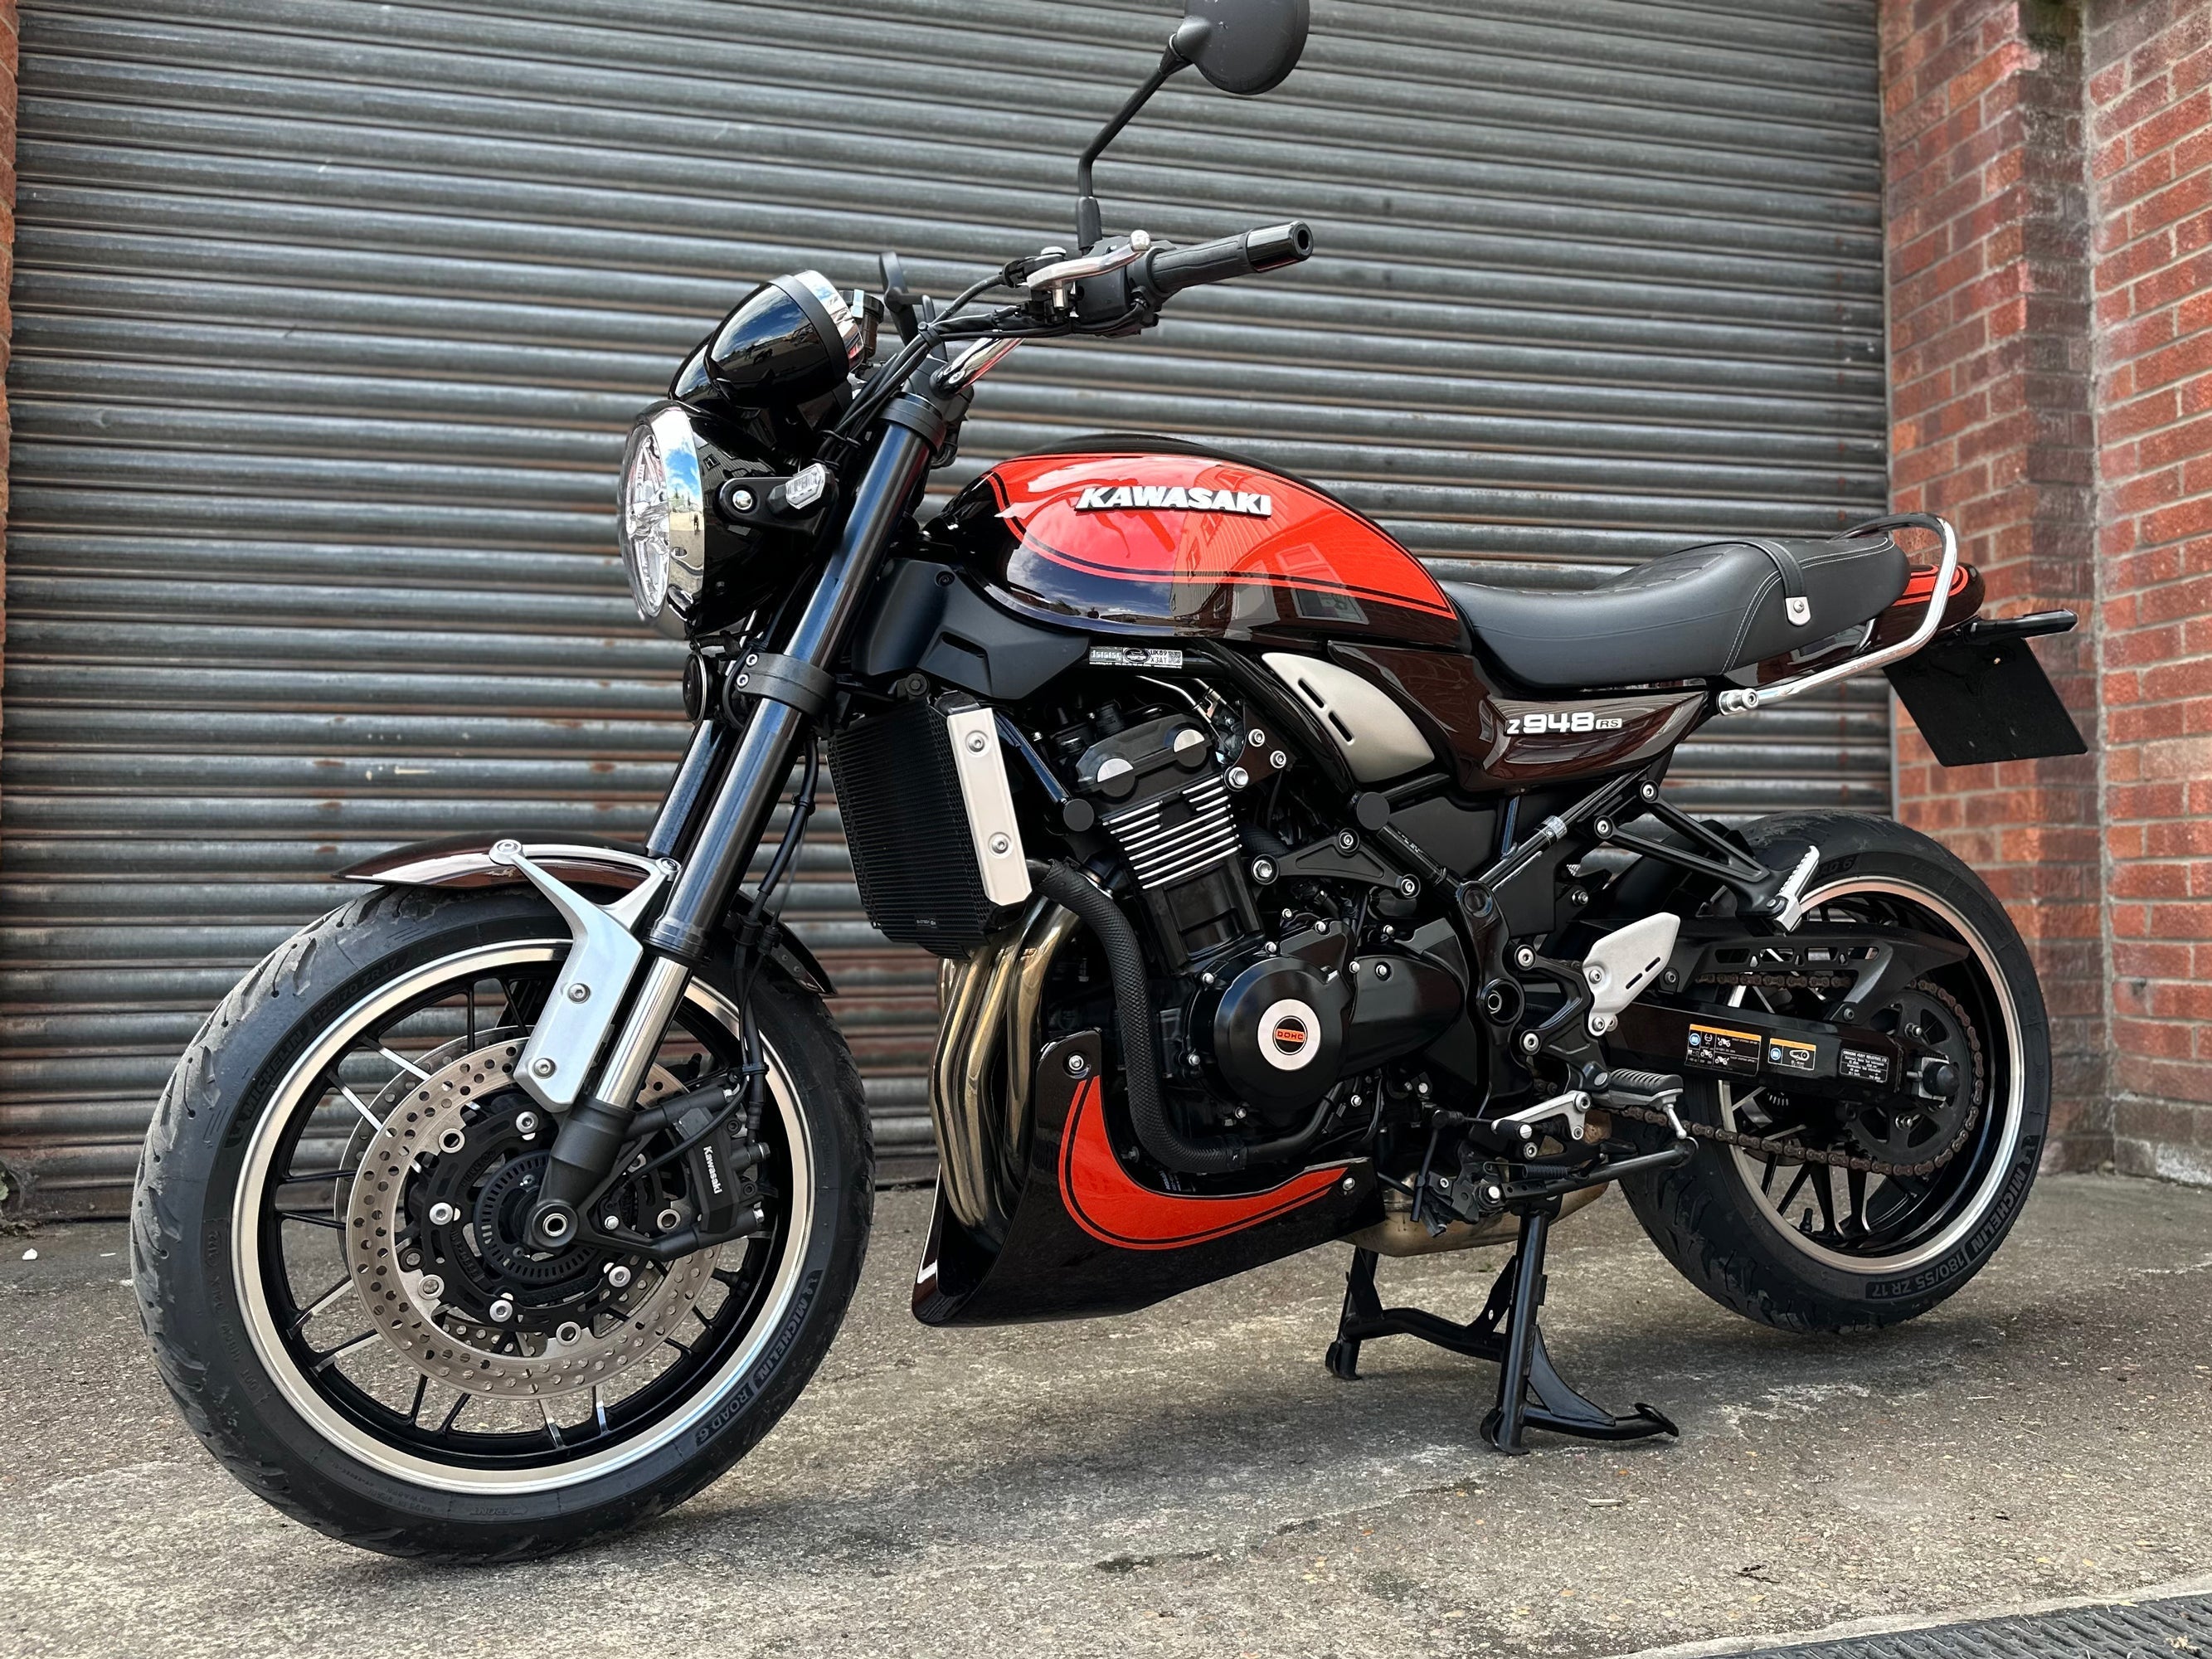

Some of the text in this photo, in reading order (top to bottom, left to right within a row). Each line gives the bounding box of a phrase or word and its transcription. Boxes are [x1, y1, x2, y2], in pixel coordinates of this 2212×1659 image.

[1076, 486, 1271, 516] KAWASAKI
[1599, 719, 1620, 728] RS
[243, 1029, 304, 1120] MICHELIN
[314, 984, 358, 1020] 120/70
[362, 970, 380, 984] ZR
[1277, 1031, 1304, 1040] DOHC
[703, 1146, 722, 1194] Kawasaki
[1872, 1166, 2026, 1297] MICHELIN 180/55 ZR 17
[755, 1301, 809, 1381] MICHELIN
[710, 1389, 751, 1432] ROAD
